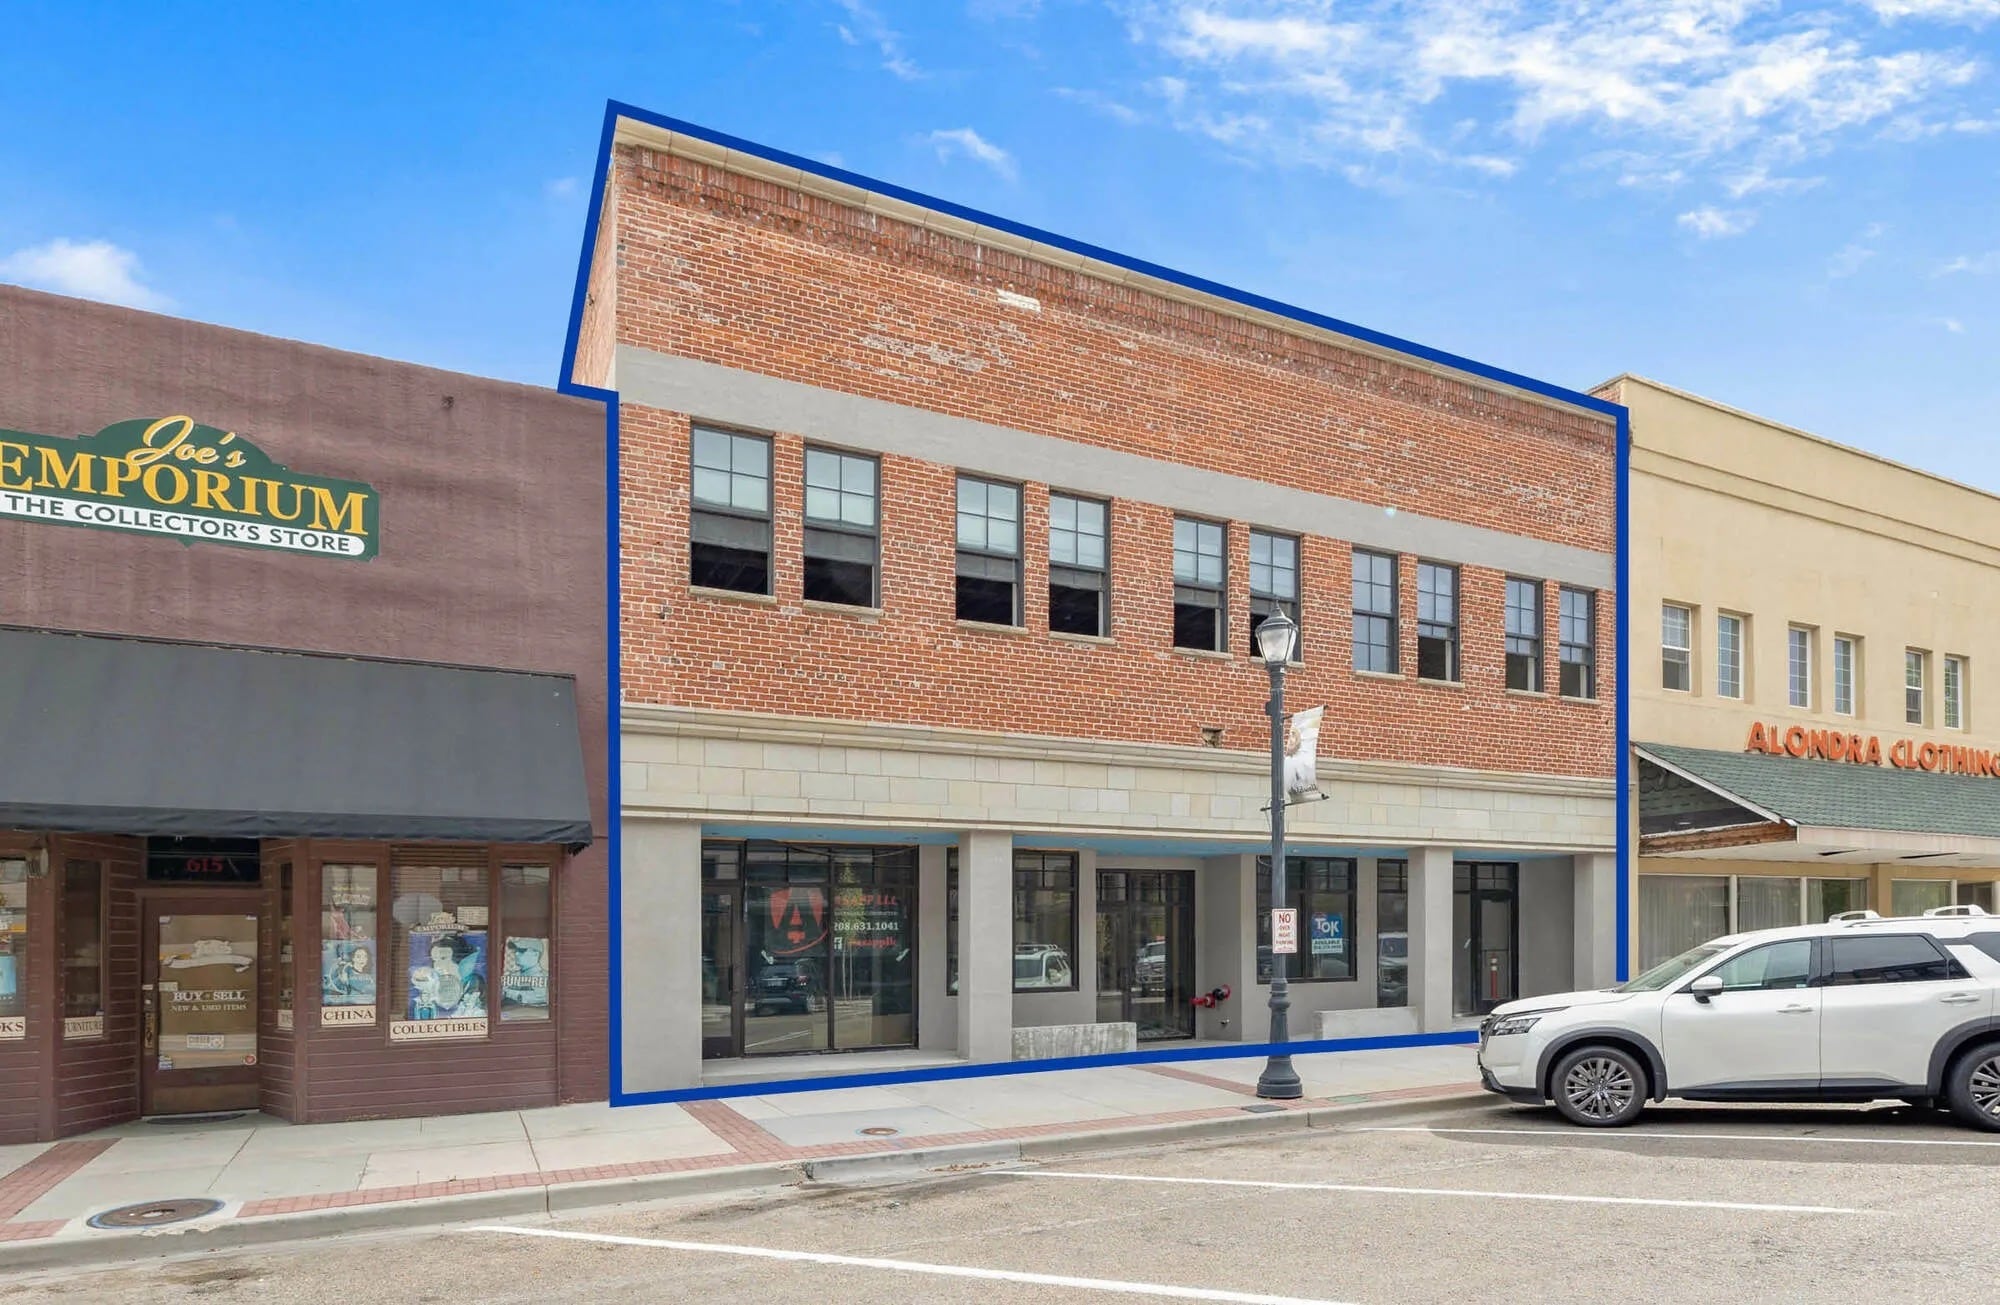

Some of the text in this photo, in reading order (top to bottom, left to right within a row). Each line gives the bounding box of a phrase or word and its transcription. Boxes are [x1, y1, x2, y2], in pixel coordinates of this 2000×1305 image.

[126, 414, 248, 467] Joe's
[0, 441, 369, 536] EMPORIUM
[4, 494, 350, 552] THE COLLECTOR'S STORE
[1744, 721, 1883, 765] ALONDRA
[1279, 913, 1291, 923] NO
[1314, 917, 1340, 937] TOK
[173, 991, 246, 1001] BUY SELL
[323, 1009, 375, 1021] CHINA
[0, 1021, 24, 1033] KS
[392, 1022, 487, 1035] COLLECTIBLES
